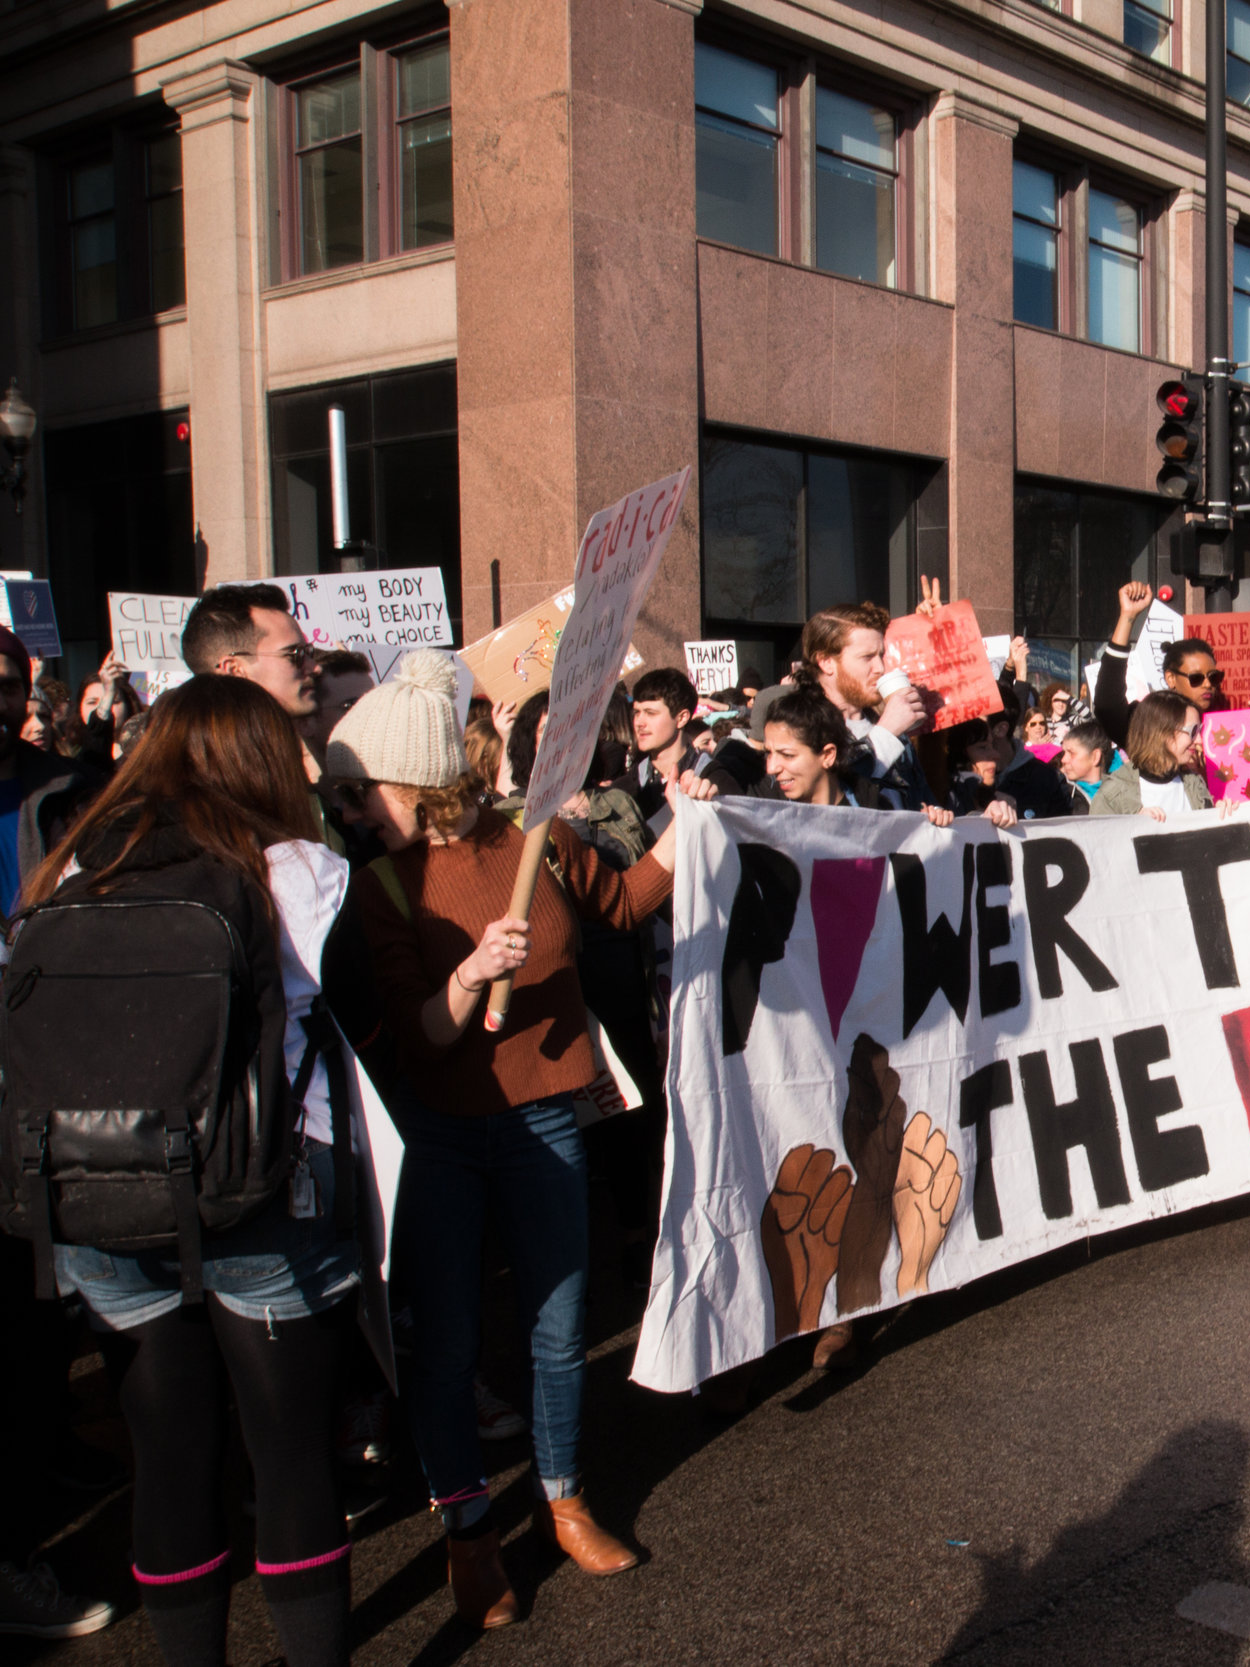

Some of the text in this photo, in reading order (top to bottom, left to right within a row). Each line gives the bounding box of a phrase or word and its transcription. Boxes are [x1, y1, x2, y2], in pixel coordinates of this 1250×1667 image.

[338, 583, 367, 602] my
[378, 576, 422, 598] BODY
[338, 602, 443, 628] my BEAUTY
[119, 629, 176, 661] FULL
[385, 625, 443, 646] CHOICE
[688, 644, 734, 663] THANKS
[960, 1024, 1209, 1241] THE
